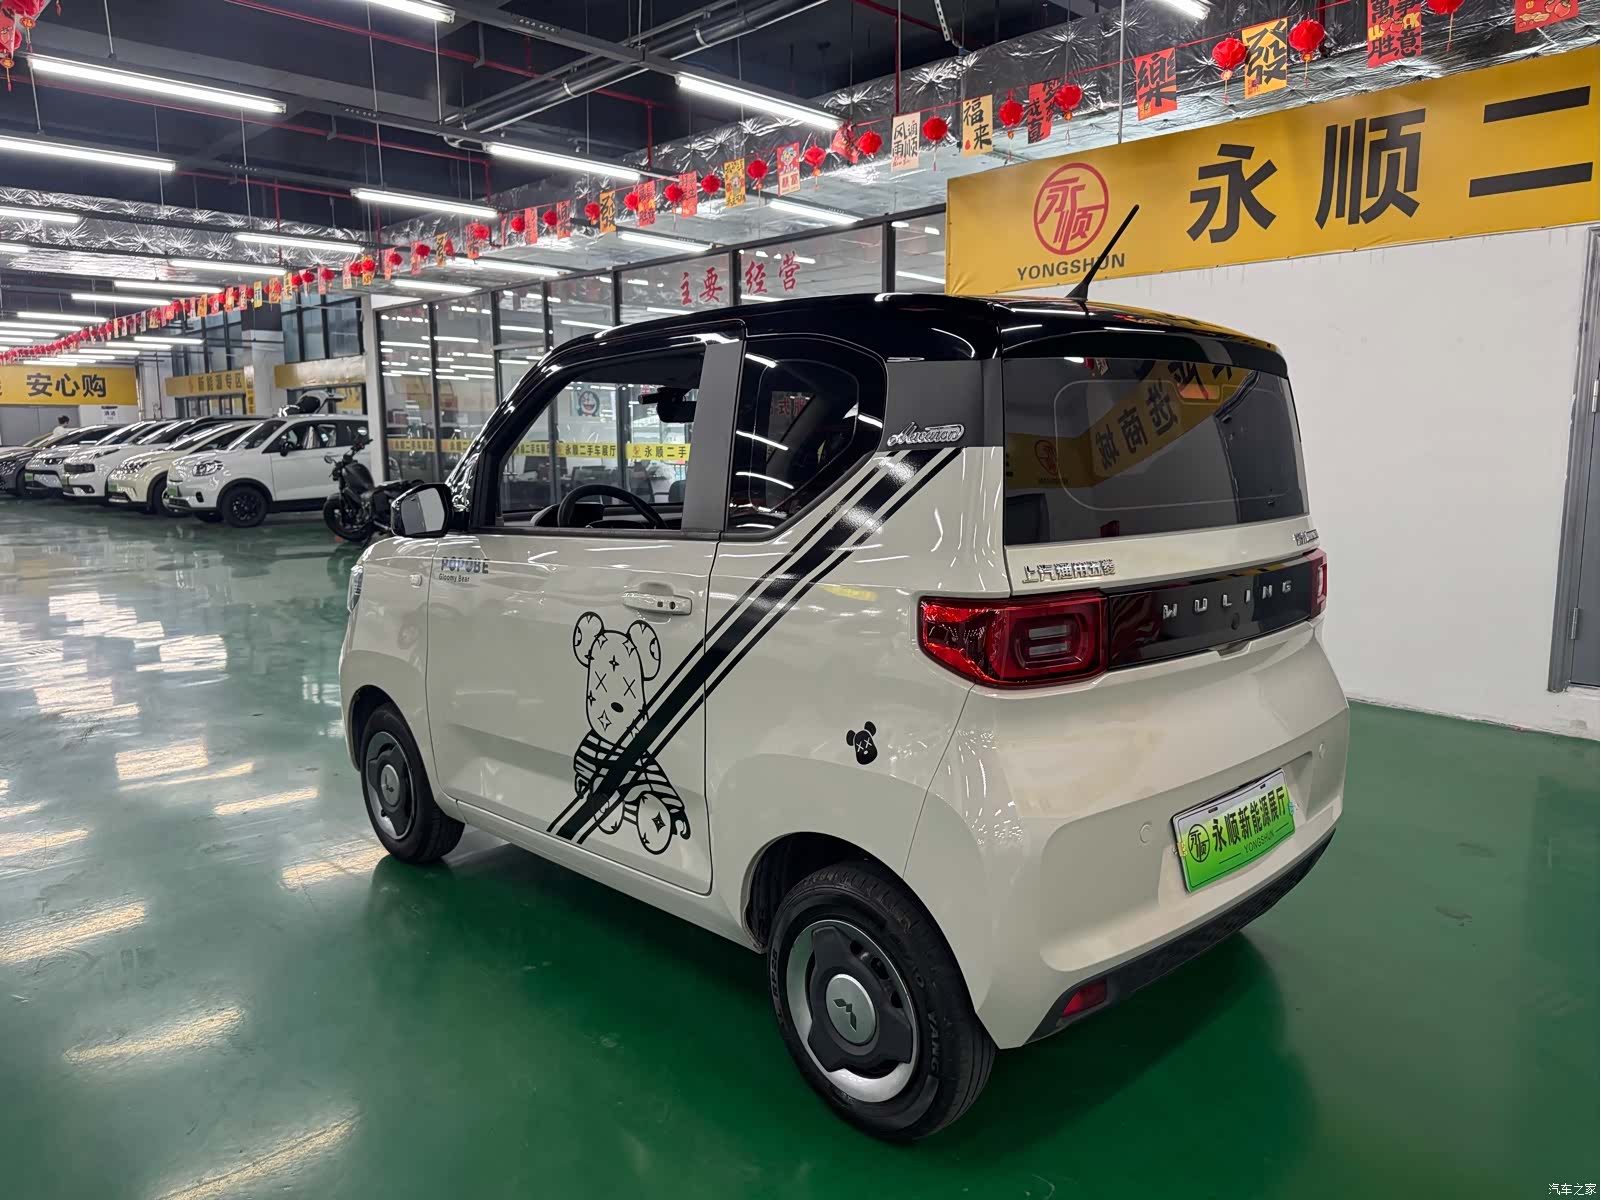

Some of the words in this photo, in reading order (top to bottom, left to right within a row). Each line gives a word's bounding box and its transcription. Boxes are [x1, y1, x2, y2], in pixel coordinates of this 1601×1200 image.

[963, 101, 993, 151] 福来
[1017, 253, 1125, 281] YONGSHUN
[26, 373, 107, 397] 安心购
[565, 444, 616, 457] 永顺二手车展厅
[644, 446, 687, 458] 永顺二手
[441, 556, 490, 574] POPOBE
[1022, 559, 1116, 584] 上汽通用五菱
[439, 573, 457, 582] Gloomy
[458, 574, 470, 583] Bear
[1162, 580, 1292, 620] WULING
[1212, 786, 1286, 852] 永顺新能源展厅
[1243, 830, 1276, 854] YONGSHUN
